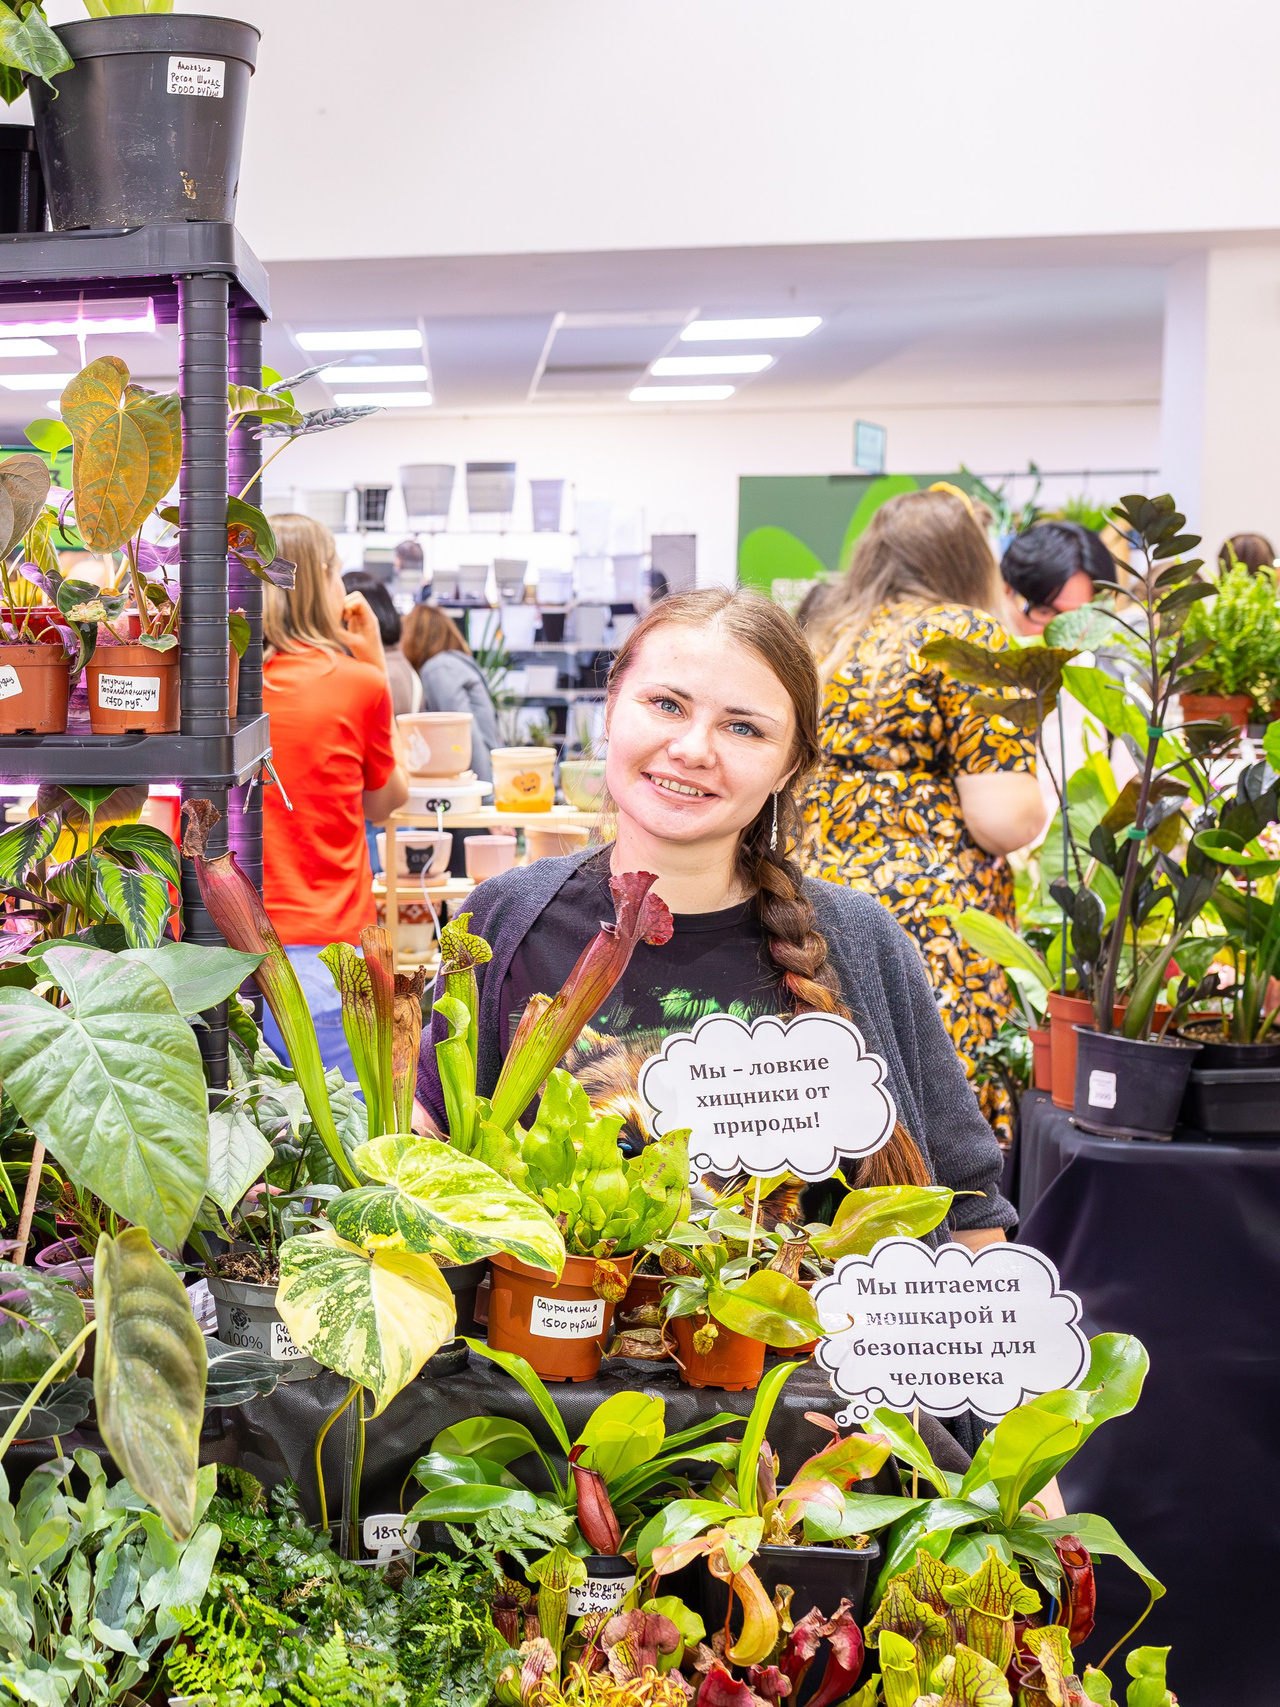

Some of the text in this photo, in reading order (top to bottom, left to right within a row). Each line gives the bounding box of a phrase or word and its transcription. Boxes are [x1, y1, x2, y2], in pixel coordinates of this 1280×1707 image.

[171, 84, 195, 94] 5000
[105, 695, 124, 707] 1750
[689, 1063, 726, 1081] Мы
[749, 1055, 830, 1076] ловкие
[696, 1084, 831, 1109] хищники от
[712, 1111, 821, 1138] природы!
[856, 1276, 1021, 1297] Мы питаемся
[536, 1298, 598, 1314] Саррацения
[542, 1316, 598, 1332] 1500 рублей
[865, 1307, 1017, 1329] мошкарой и
[227, 1330, 264, 1350] 100%
[852, 1337, 1037, 1359] безопасны для
[889, 1369, 1005, 1387] человека
